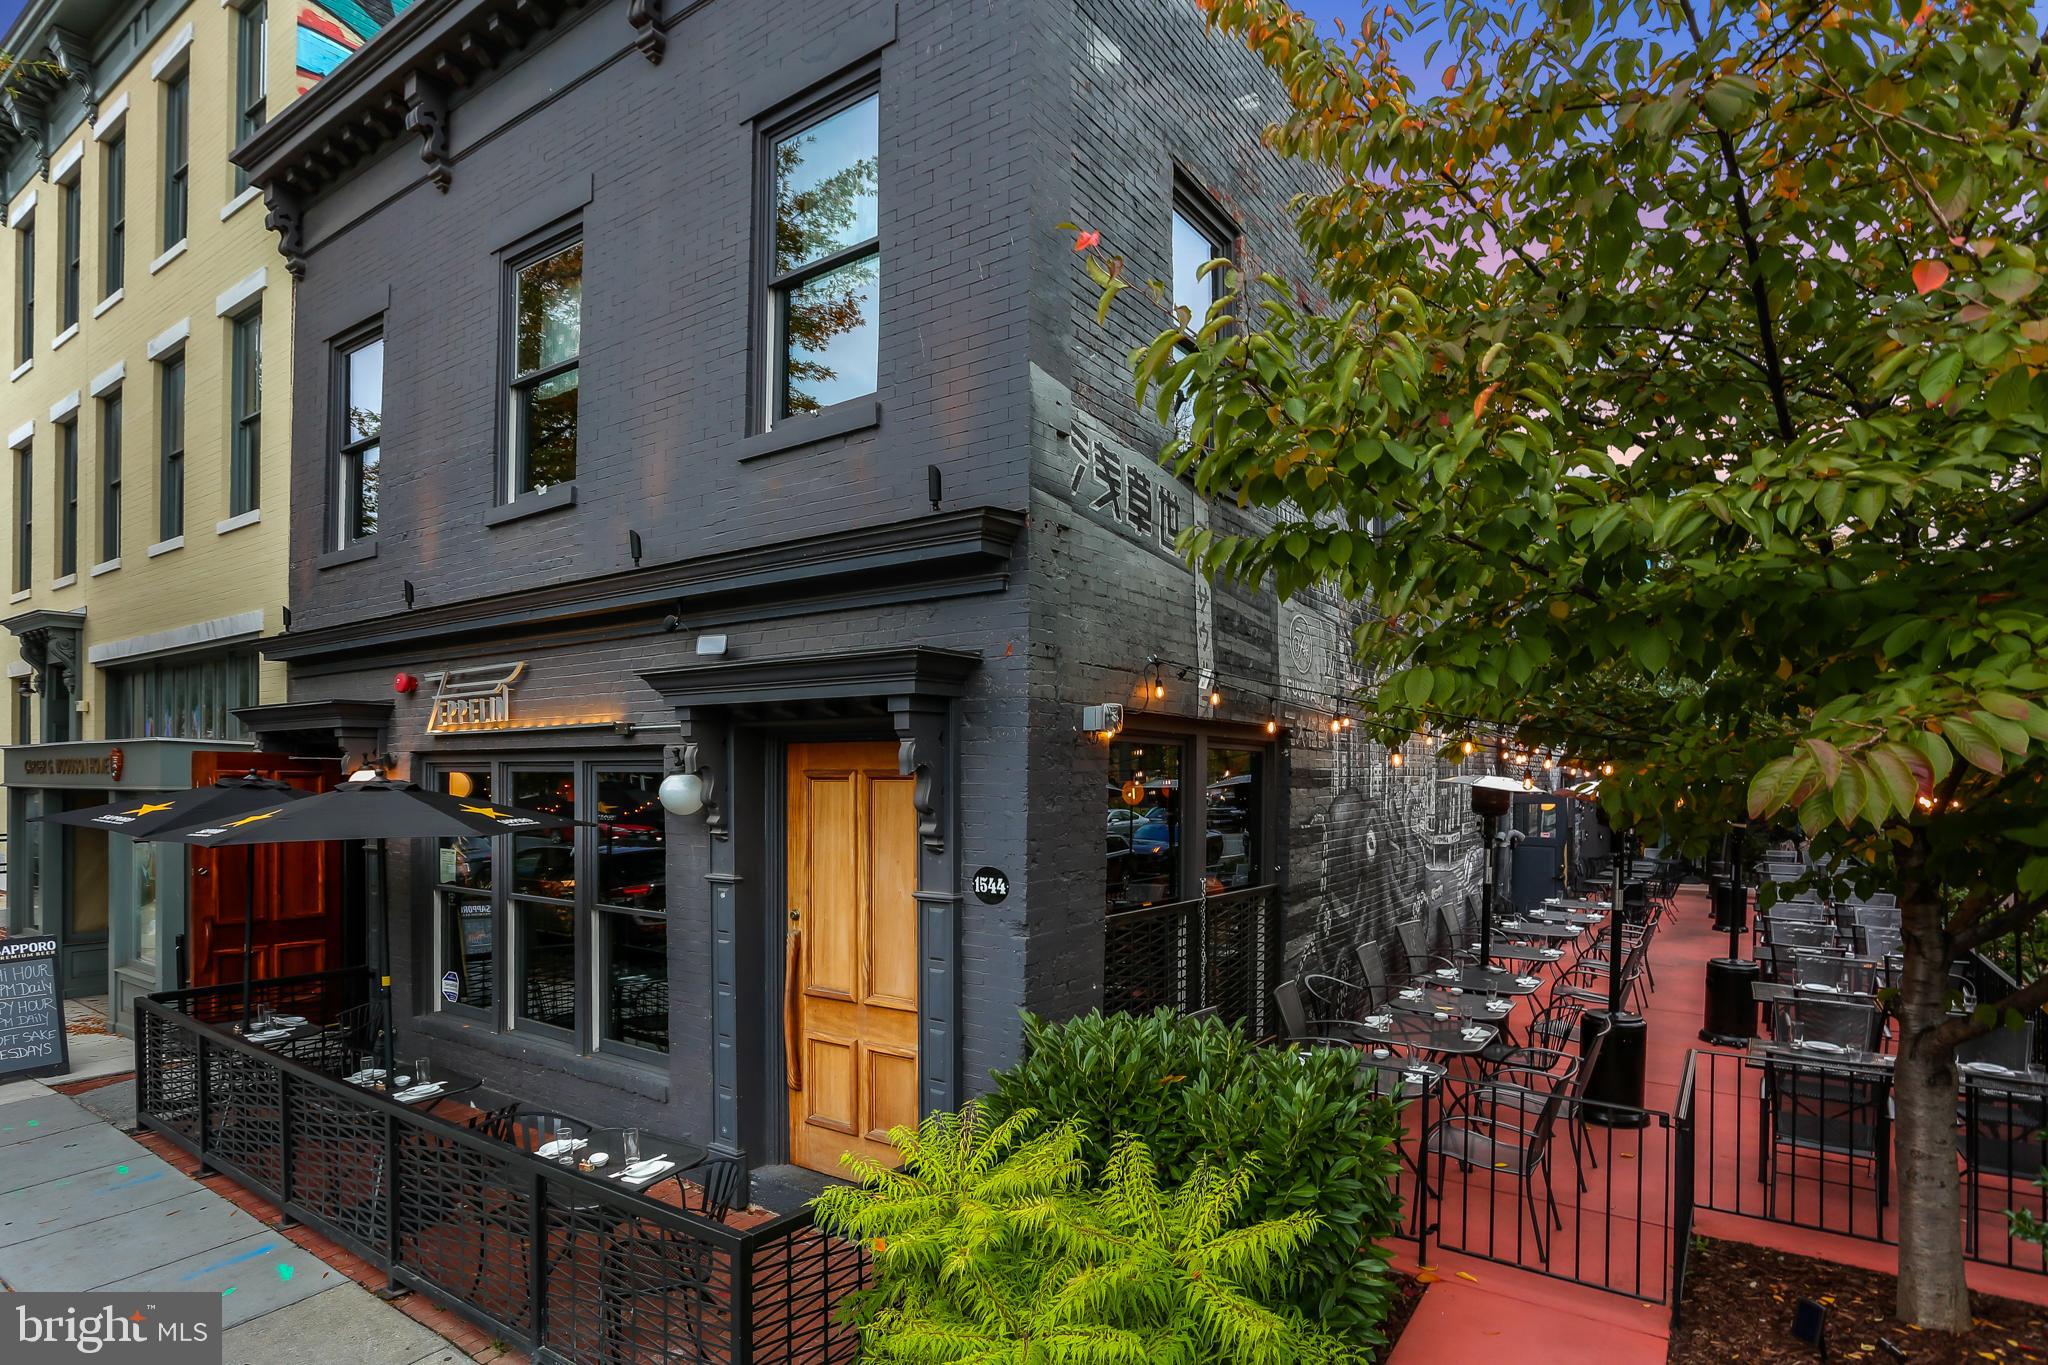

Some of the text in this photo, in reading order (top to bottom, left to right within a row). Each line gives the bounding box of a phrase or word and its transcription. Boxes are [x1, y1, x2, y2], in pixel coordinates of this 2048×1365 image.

[424, 661, 526, 734] ZEPPELIN
[975, 876, 1006, 894] 1544
[0, 940, 57, 956] APPORO
[12, 963, 54, 981] HOUR
[16, 980, 53, 996] Daily
[18, 998, 57, 1014] HOUR
[22, 1029, 57, 1043] SAKE
